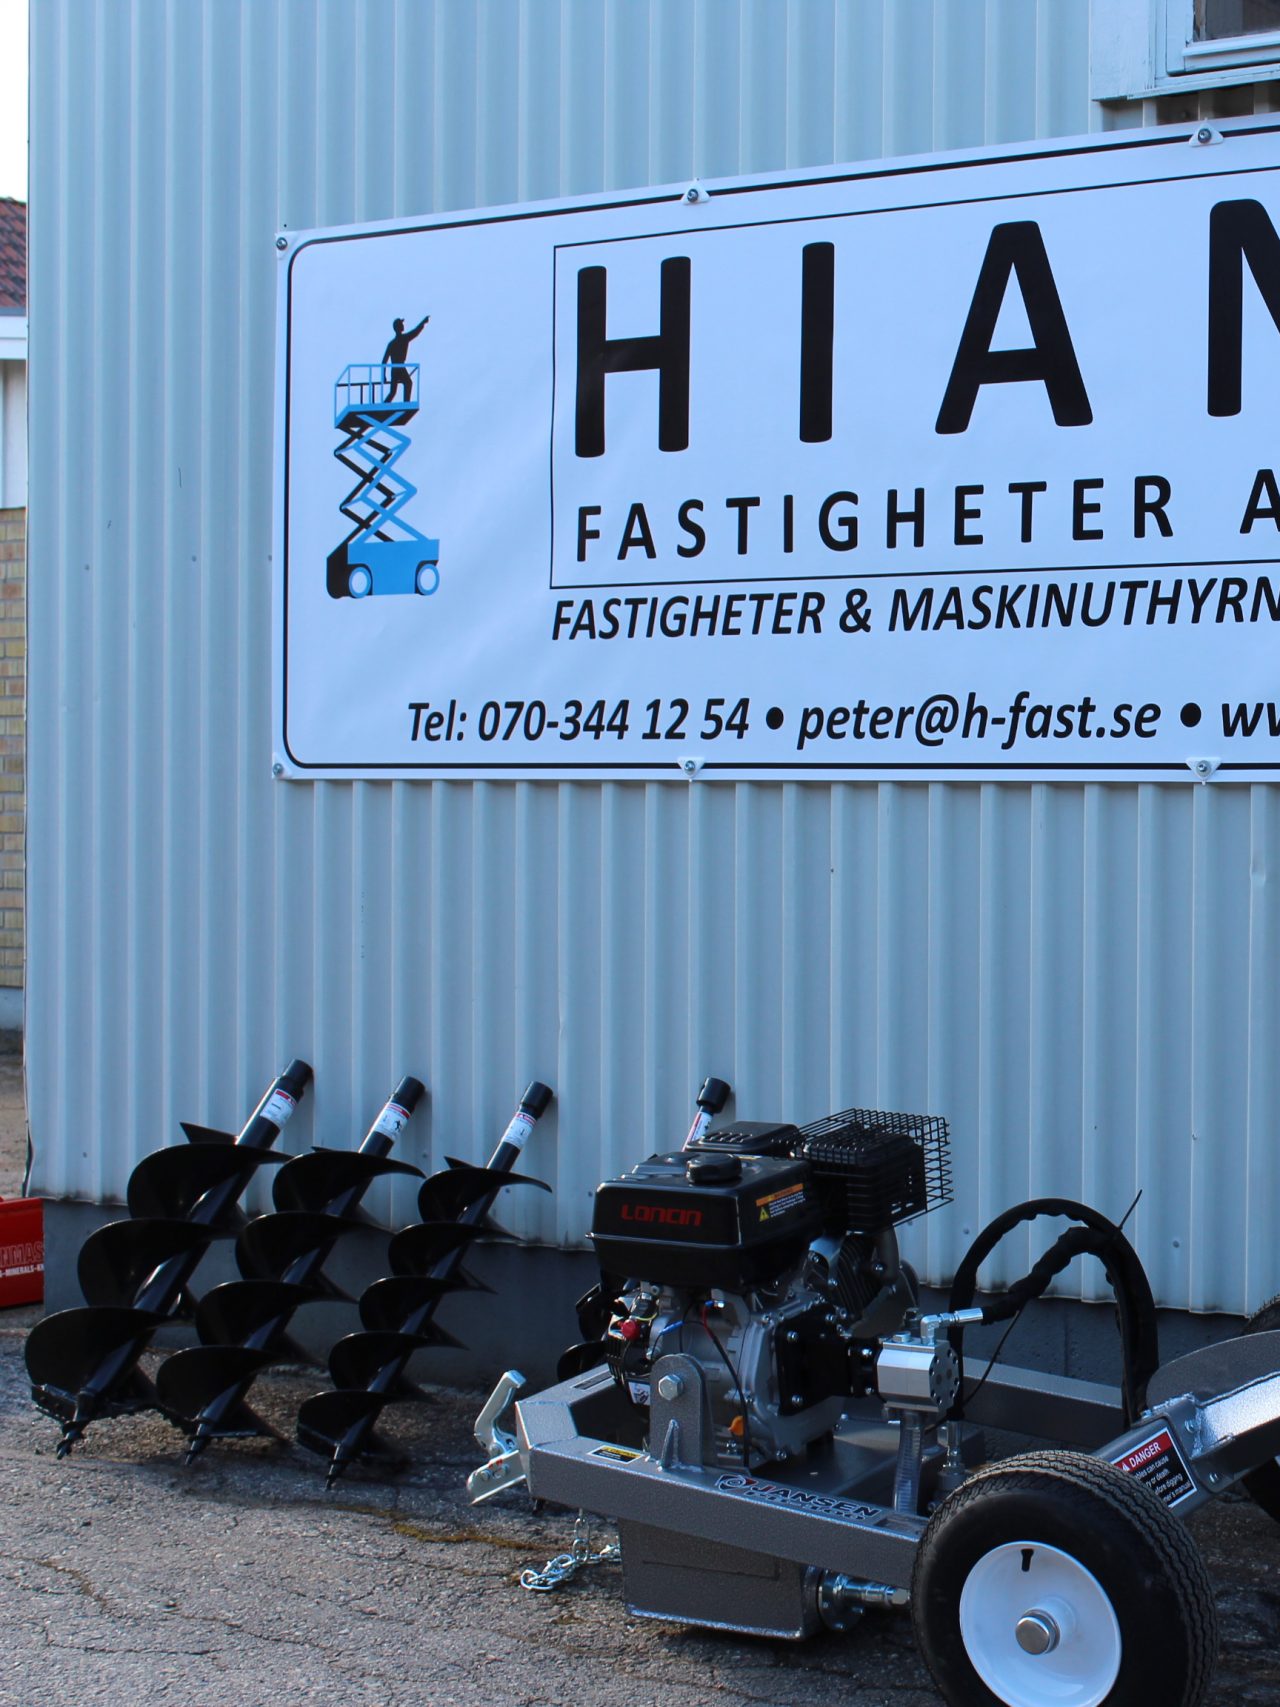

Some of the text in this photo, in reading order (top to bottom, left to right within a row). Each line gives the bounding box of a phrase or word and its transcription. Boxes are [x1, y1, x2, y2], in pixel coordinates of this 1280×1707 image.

[576, 476, 1174, 562] FASTIGHETER
[552, 592, 825, 640] FASTIGHETER
[839, 592, 872, 634] &
[409, 700, 466, 741] Tel:
[479, 700, 629, 741] 070-344
[642, 699, 688, 739] 12
[701, 698, 749, 739] 54
[797, 691, 1161, 750] peter@h-fast.se
[1129, 1442, 1161, 1467] DANGER
[751, 1485, 882, 1517] JANSEN
